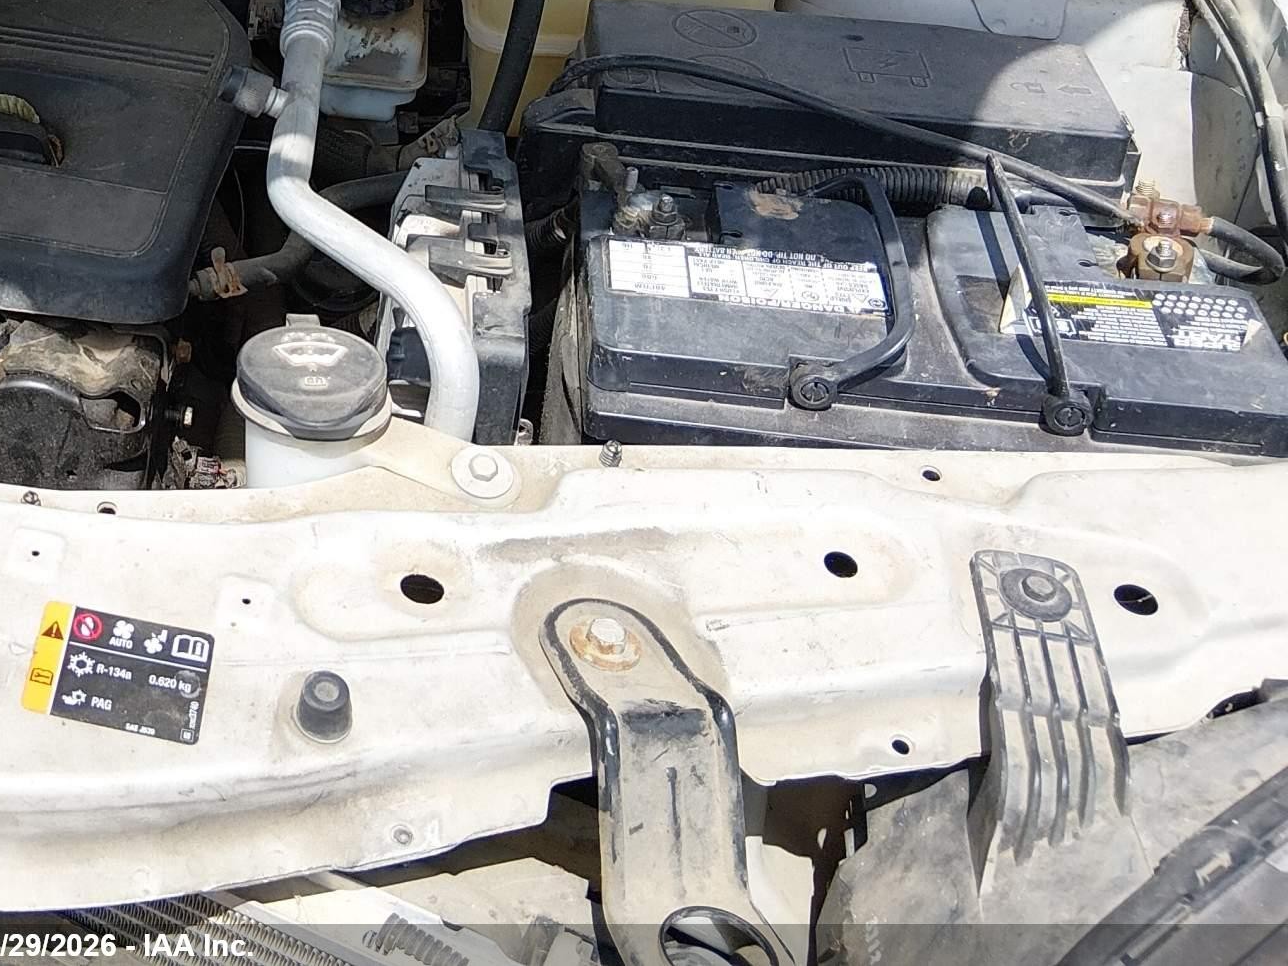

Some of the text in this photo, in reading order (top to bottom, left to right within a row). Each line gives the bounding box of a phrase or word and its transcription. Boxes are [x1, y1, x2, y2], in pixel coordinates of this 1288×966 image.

[109, 636, 133, 650] AUTO
[96, 662, 192, 694] R-134a 0.620 kg
[90, 696, 112, 711] PAG
